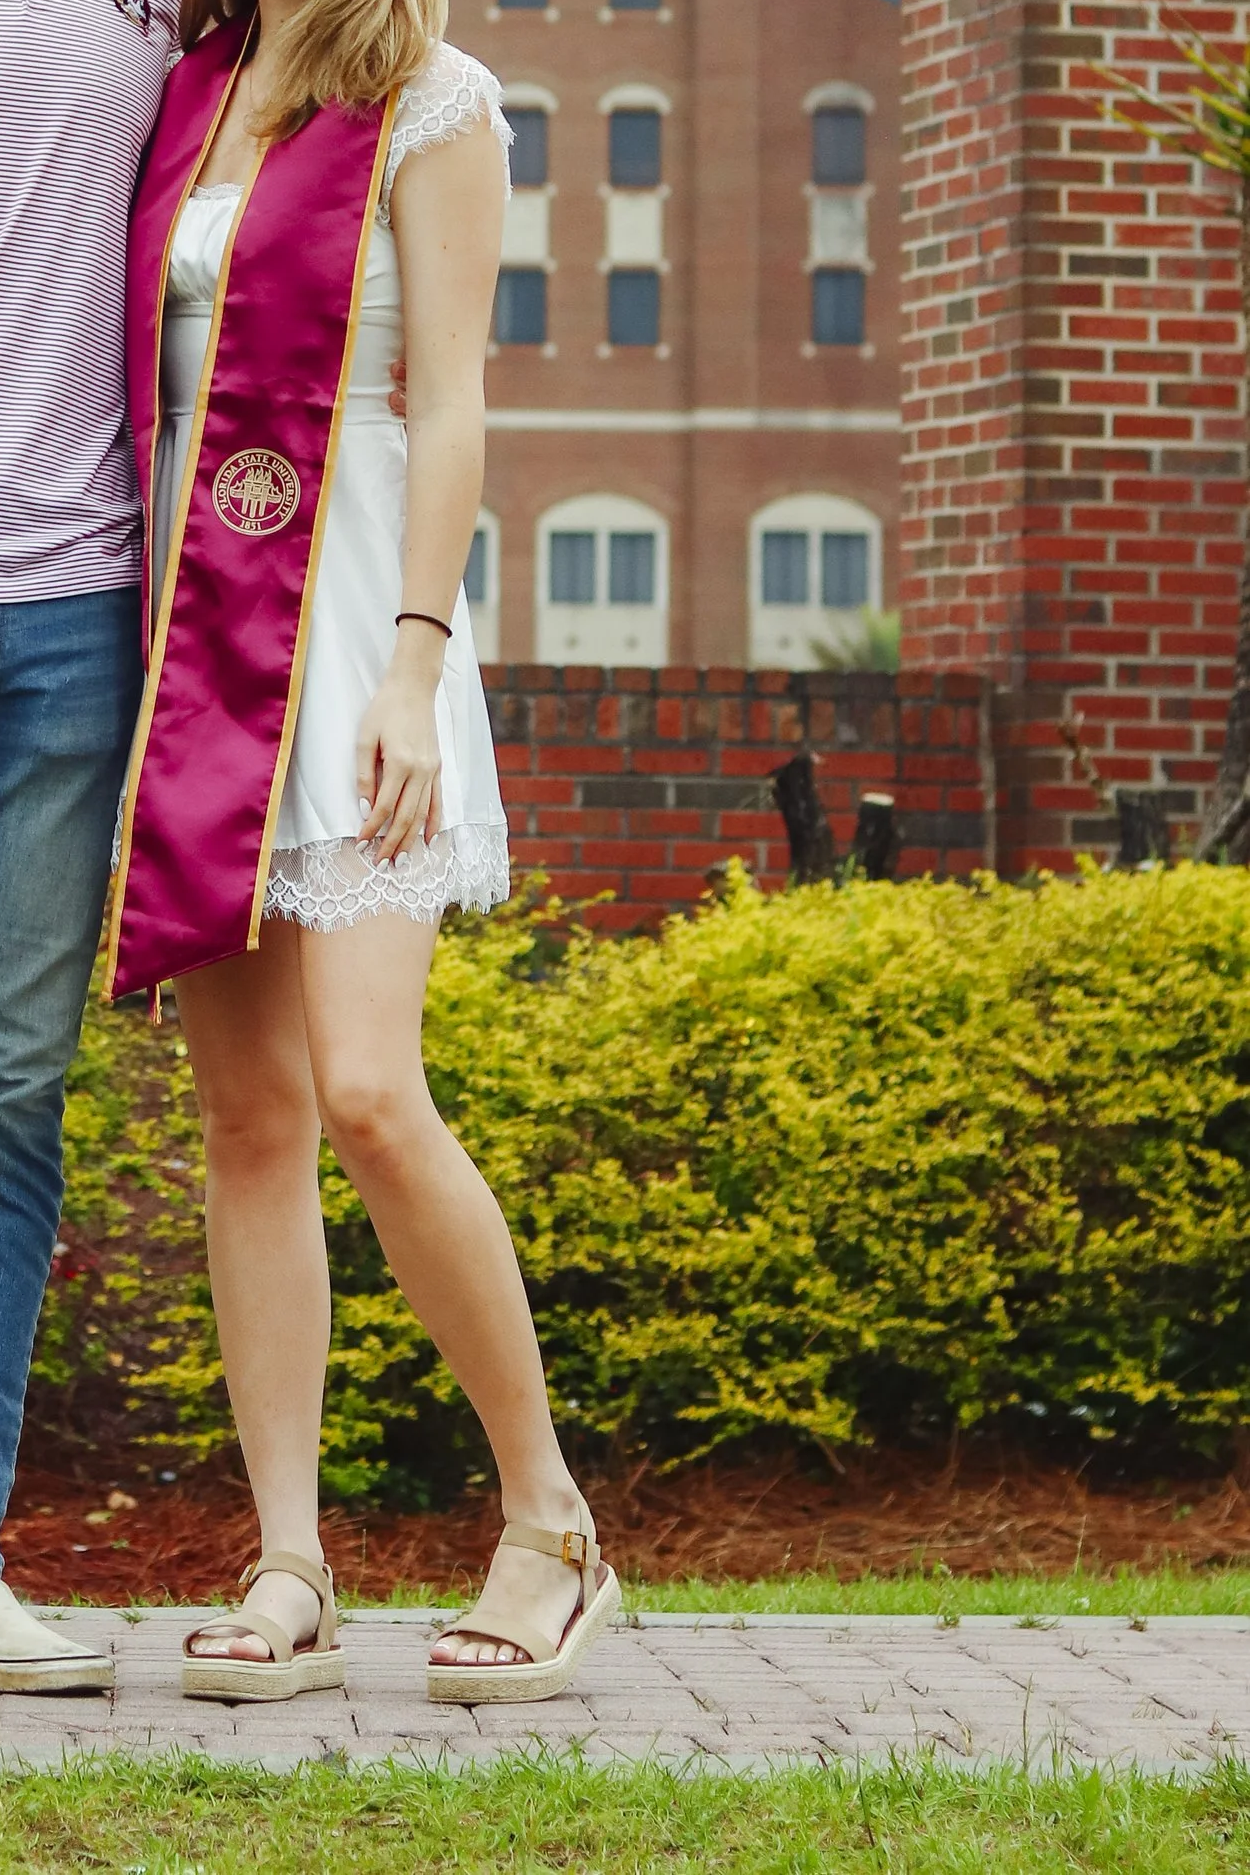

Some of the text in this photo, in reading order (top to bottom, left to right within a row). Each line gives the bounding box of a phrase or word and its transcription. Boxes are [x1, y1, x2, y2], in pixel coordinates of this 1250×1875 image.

[218, 454, 294, 519] FLORIDA STATE UNIVERSITY
[240, 520, 261, 530] 1851
